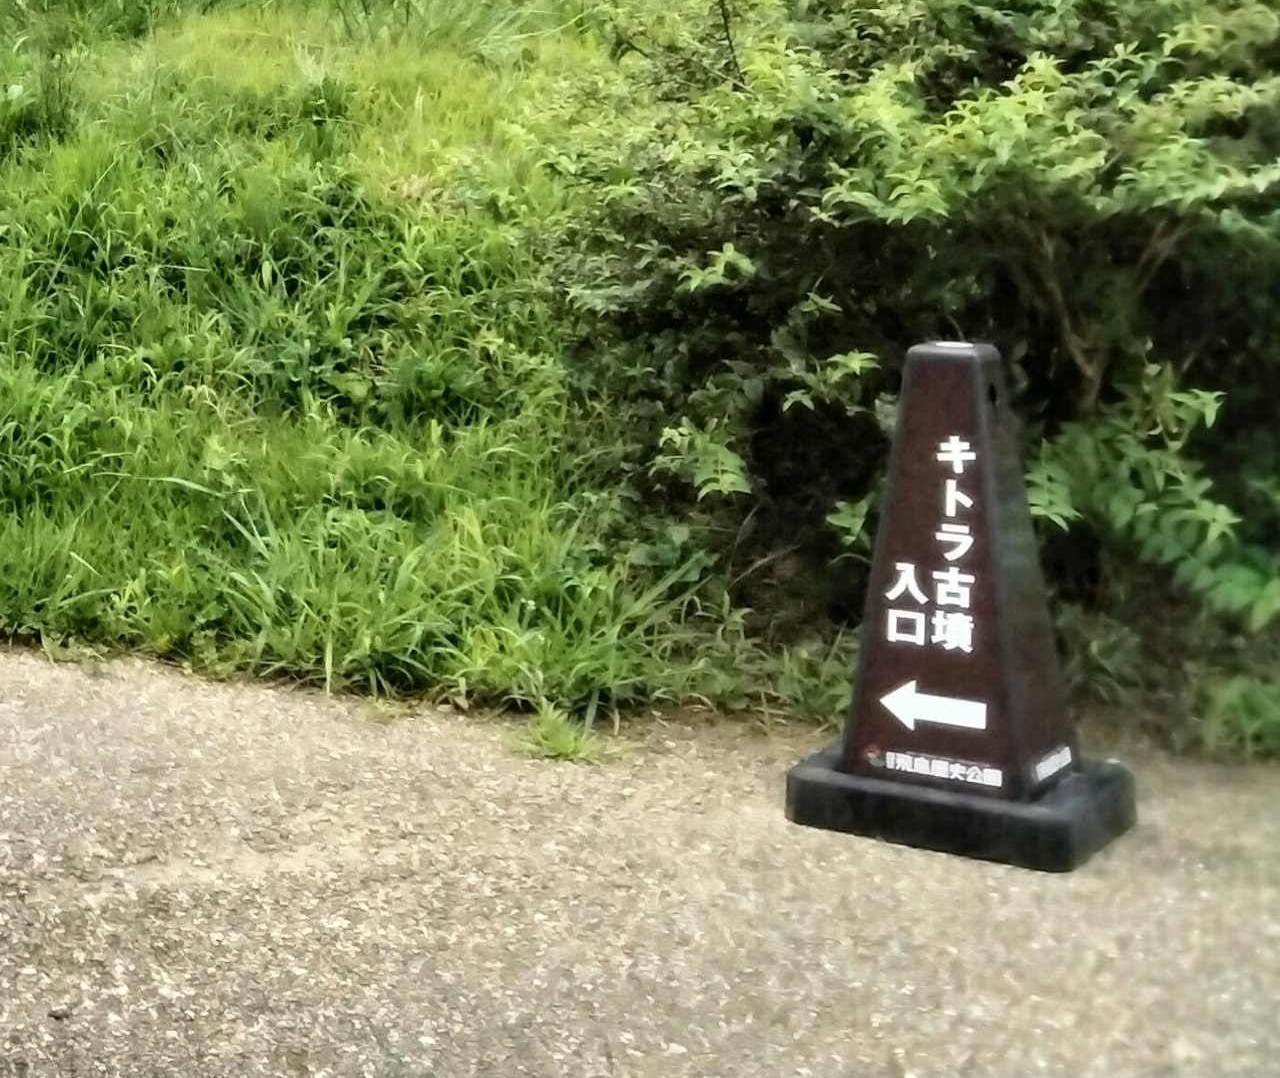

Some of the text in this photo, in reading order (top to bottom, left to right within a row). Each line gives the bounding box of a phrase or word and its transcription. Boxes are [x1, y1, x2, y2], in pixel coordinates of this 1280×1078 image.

[885, 562, 929, 647] 入口
[931, 435, 977, 654] キトラ古墳
